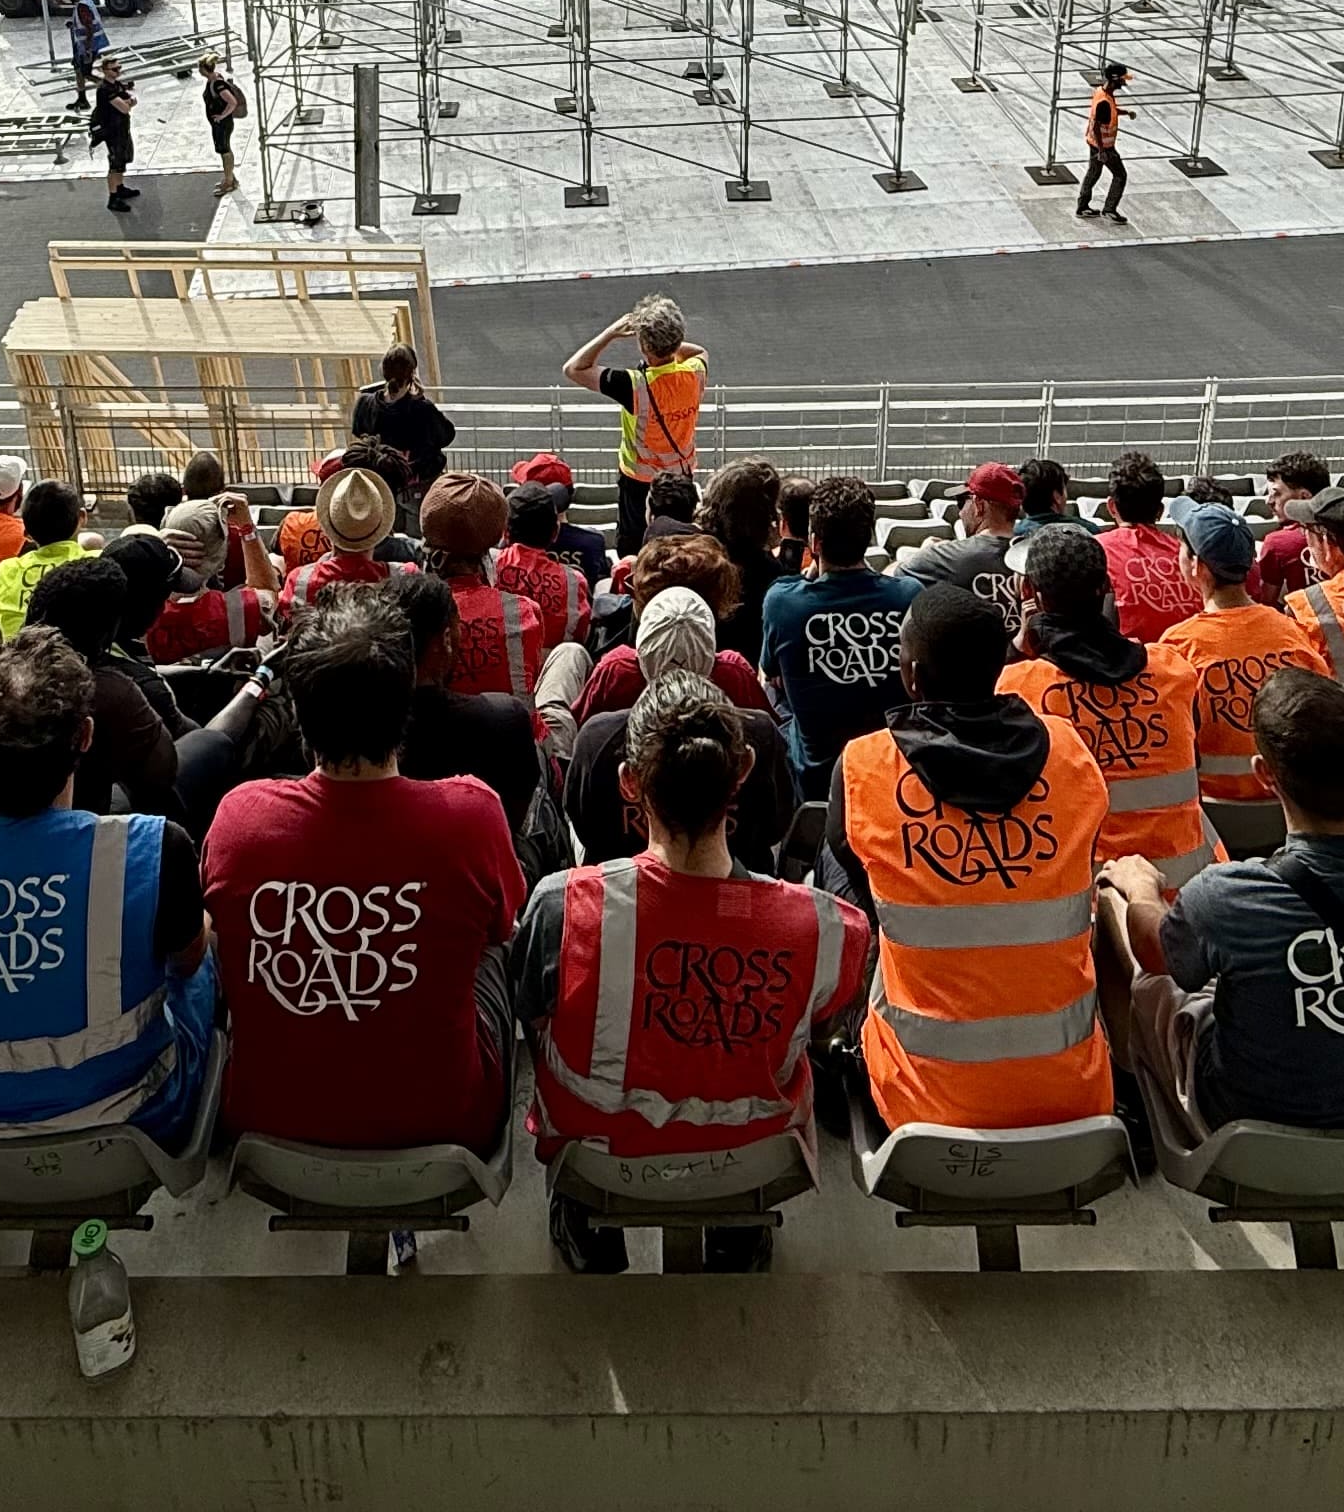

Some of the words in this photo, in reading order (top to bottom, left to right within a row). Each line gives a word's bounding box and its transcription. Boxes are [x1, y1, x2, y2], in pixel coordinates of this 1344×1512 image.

[499, 566, 562, 593] CROSS
[805, 611, 903, 647] CROSS
[808, 644, 902, 687] ROADS
[901, 810, 1060, 889] ROADS
[249, 880, 426, 953] CROSS
[247, 938, 419, 1023] ROADS
[644, 939, 794, 1004] CROSS
[643, 989, 784, 1052] ROADS
